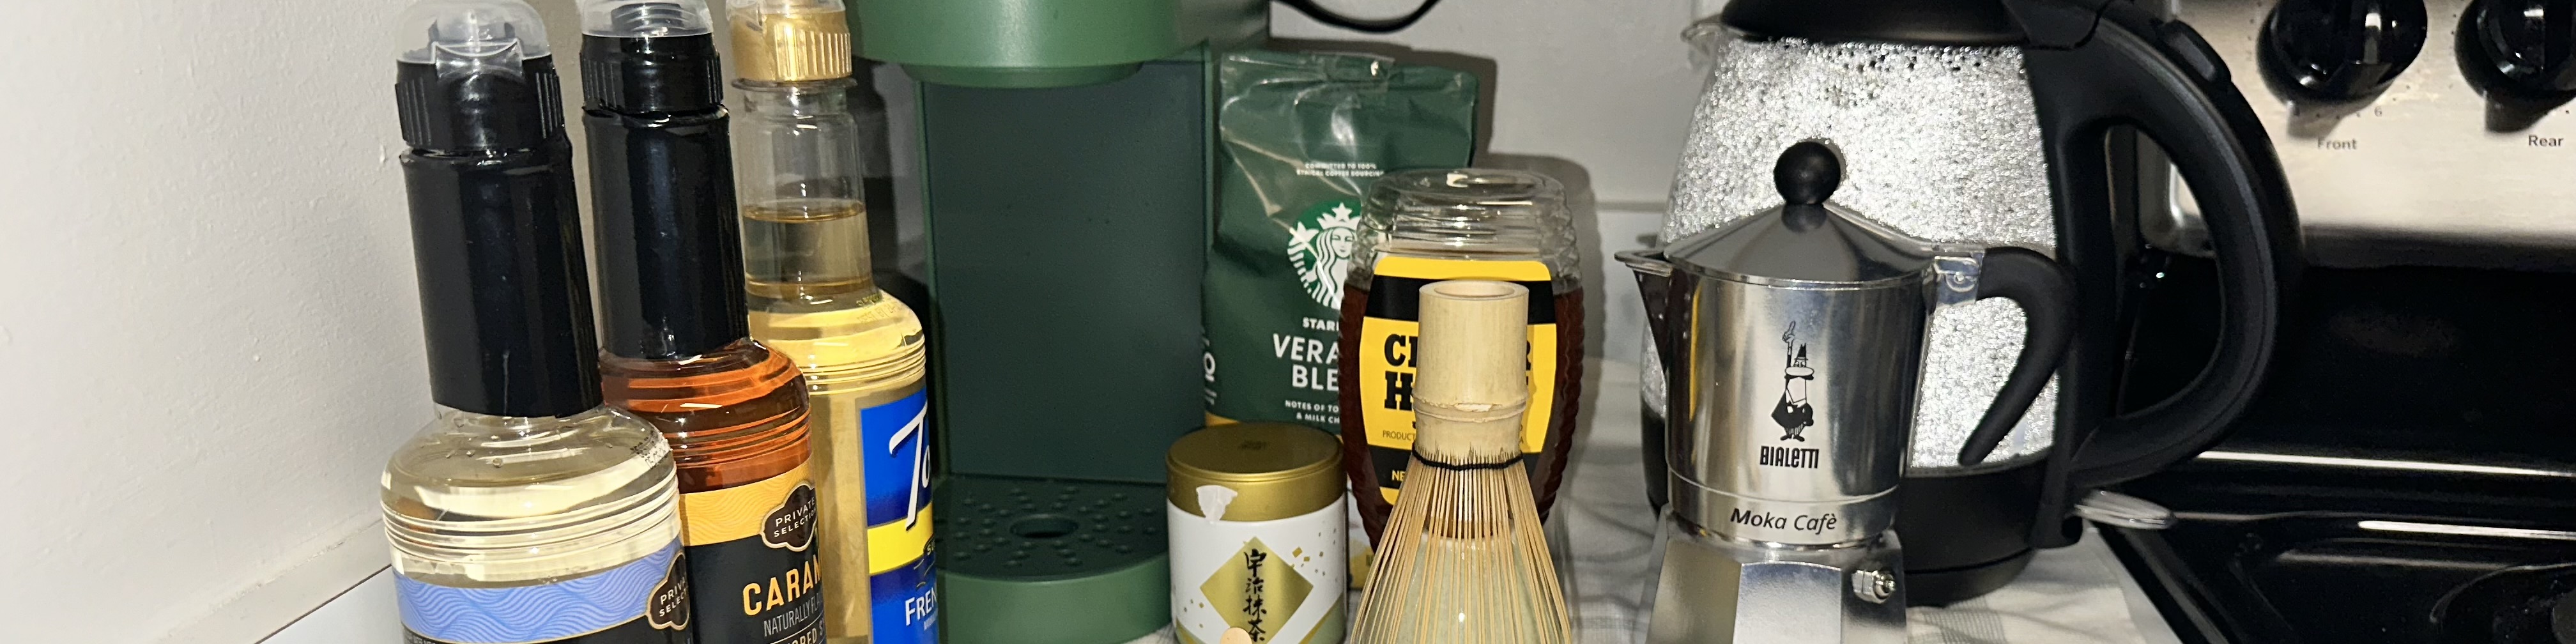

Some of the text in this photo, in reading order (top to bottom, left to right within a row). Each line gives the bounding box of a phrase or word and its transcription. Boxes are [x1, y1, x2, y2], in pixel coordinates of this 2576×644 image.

[2317, 137, 2358, 150] Front
[2528, 134, 2564, 148] Rear
[1303, 317, 1339, 331] STAR
[1273, 333, 1339, 364] VERA
[1292, 364, 1339, 391] BLE
[1285, 399, 1312, 410] NOTES
[1305, 413, 1326, 422] MILK
[776, 496, 815, 527] PRIVATE
[1730, 507, 1837, 535] Moka Cafè
[763, 598, 811, 637] NATURALLY
